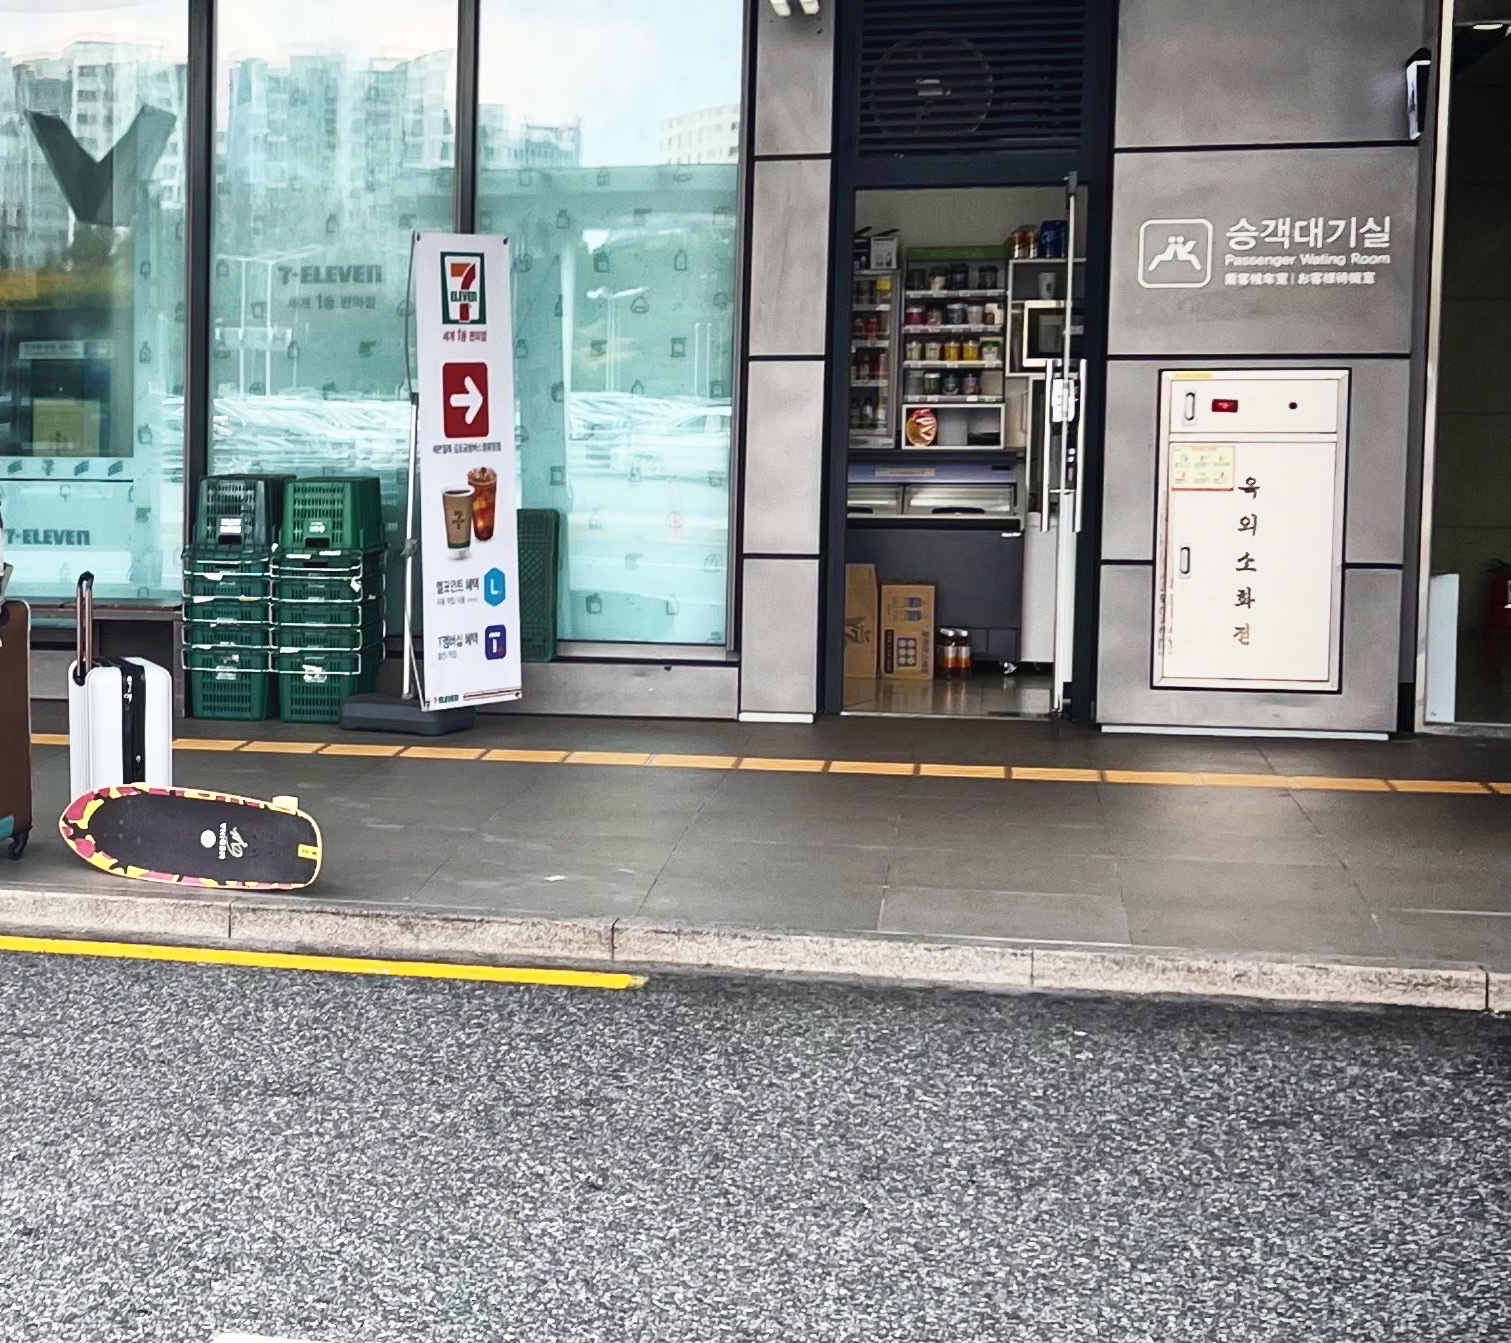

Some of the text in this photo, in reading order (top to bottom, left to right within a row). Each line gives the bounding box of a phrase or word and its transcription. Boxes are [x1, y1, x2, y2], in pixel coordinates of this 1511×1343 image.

[1225, 216, 1391, 250] 승객대기실
[1224, 254, 1296, 267] Passenger
[1350, 252, 1390, 265] Room
